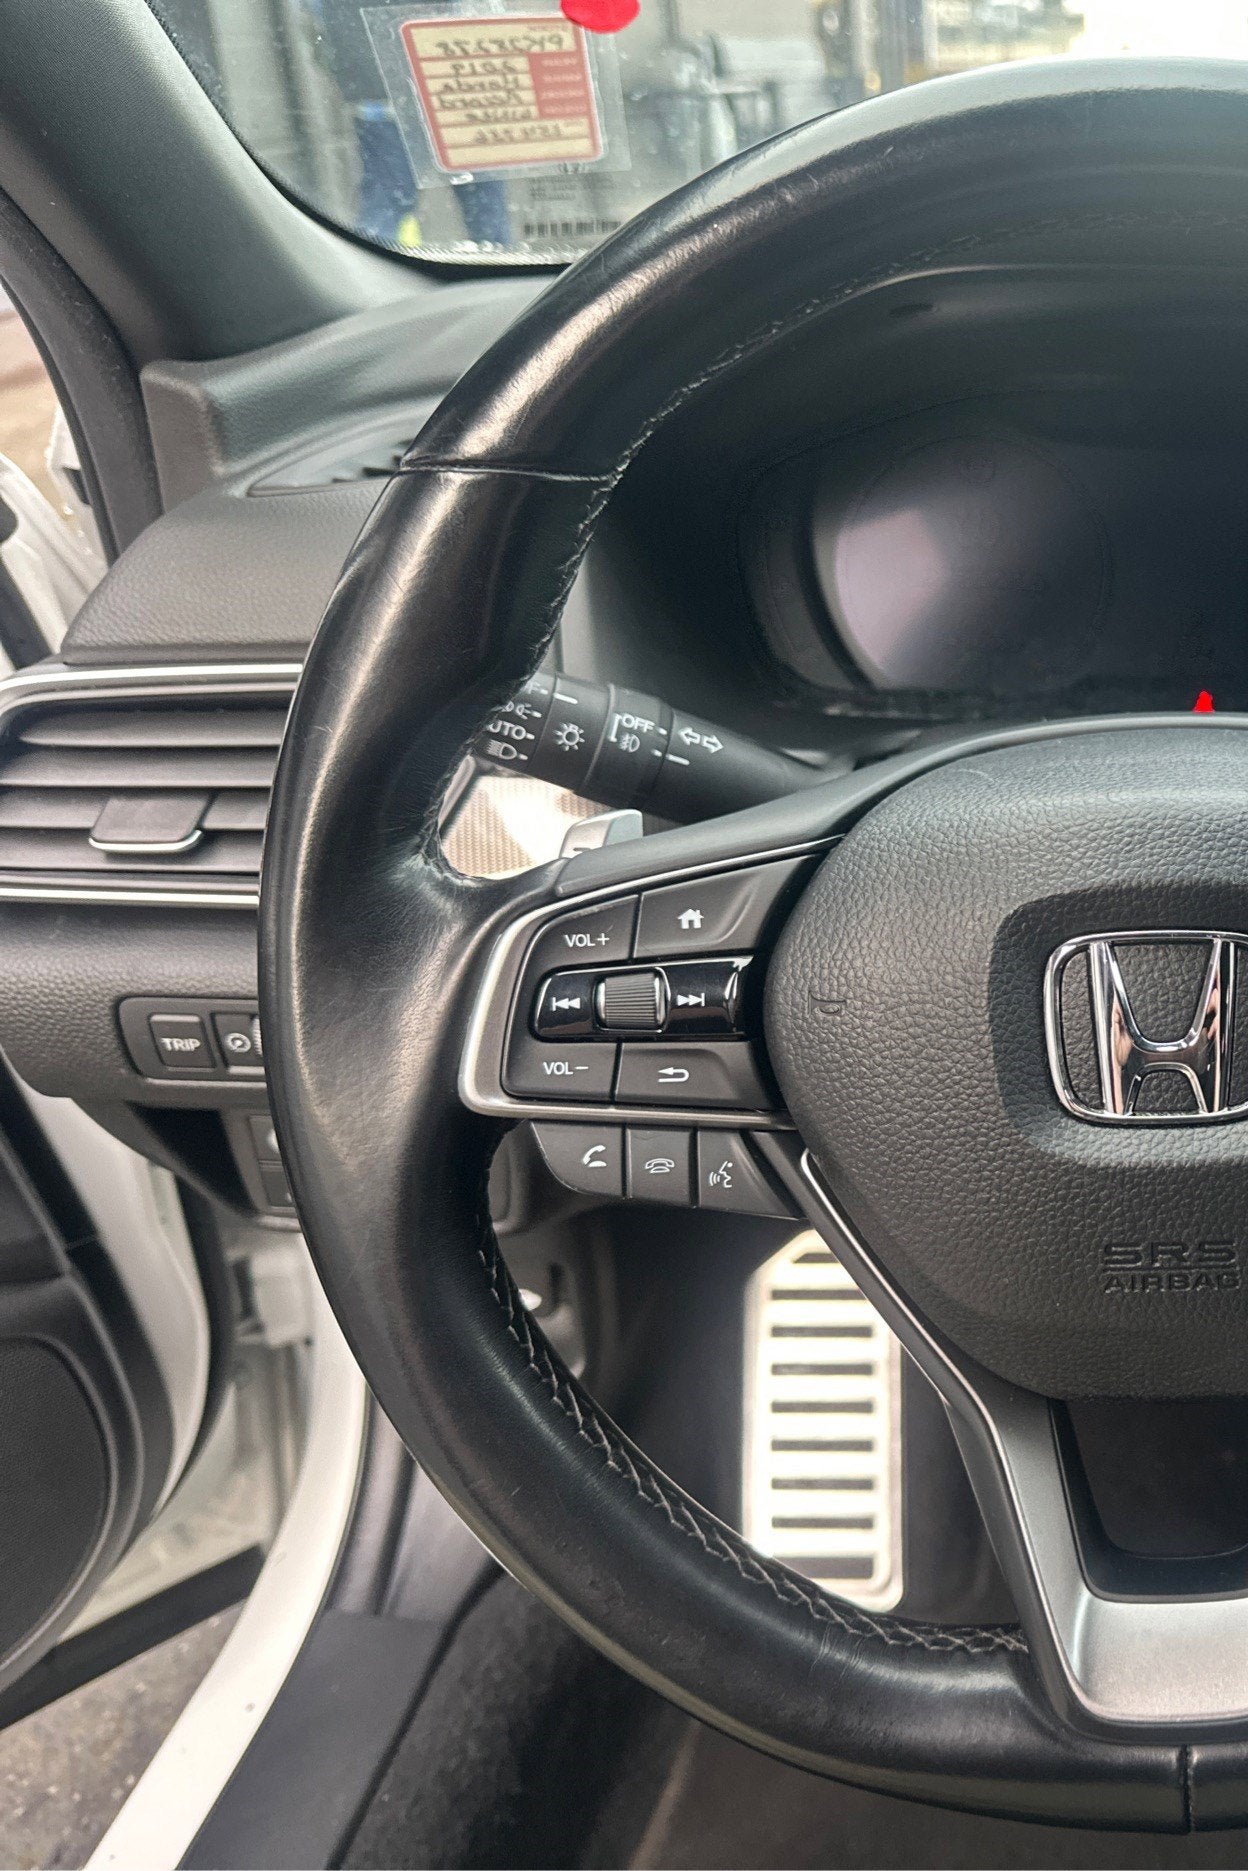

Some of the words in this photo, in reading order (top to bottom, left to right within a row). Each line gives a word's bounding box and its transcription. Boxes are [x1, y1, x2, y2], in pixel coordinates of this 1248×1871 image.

[488, 719, 527, 740] UTO
[621, 715, 655, 735] OFF
[161, 1037, 200, 1051] TRIP
[1104, 1242, 1237, 1269] SRS
[1103, 1273, 1241, 1293] AIRBAG
